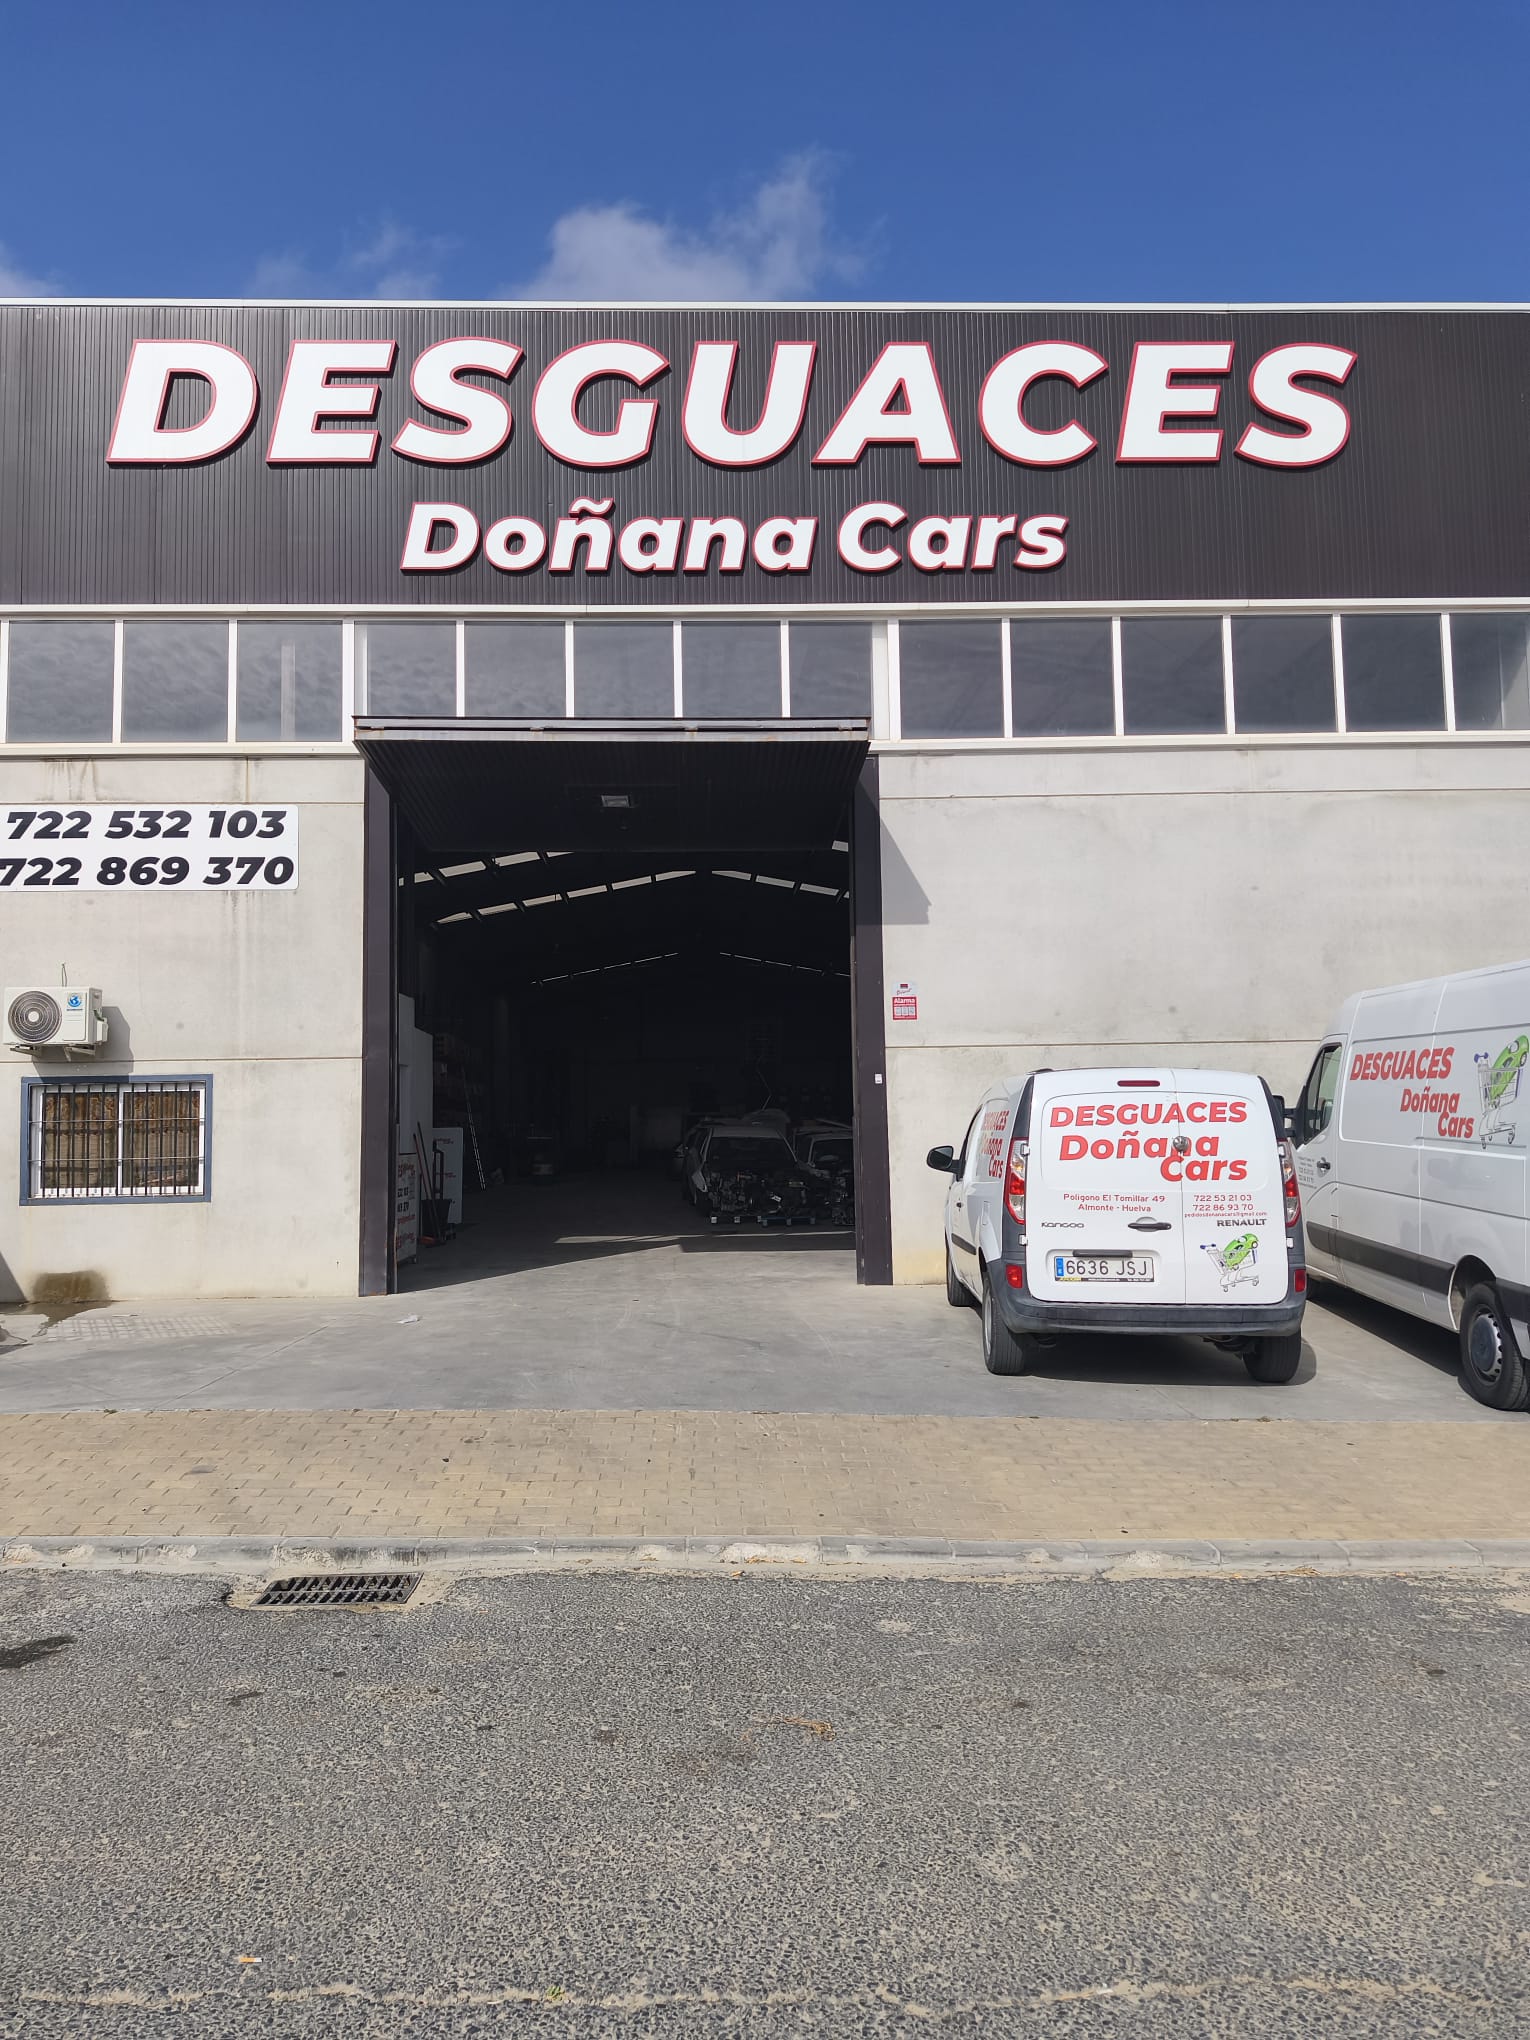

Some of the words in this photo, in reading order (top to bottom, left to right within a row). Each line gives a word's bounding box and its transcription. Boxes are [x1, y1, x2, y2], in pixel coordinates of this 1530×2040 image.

[106, 337, 1357, 467] DESGUACES
[400, 497, 817, 572] Doñana
[838, 501, 1069, 572] Cars
[7, 811, 92, 839] 722
[104, 810, 192, 839] 532
[208, 810, 287, 839] 103
[0, 857, 83, 886] 722
[97, 856, 190, 885] 869
[203, 856, 294, 885] 370
[1350, 1047, 1455, 1080] DESGUACES
[1400, 1086, 1460, 1113] Doñana
[1050, 1101, 1248, 1128] DESGUACES
[1437, 1111, 1474, 1138] Cars
[1160, 1154, 1247, 1182] Cars
[1078, 1203, 1114, 1211] Almonte
[1122, 1204, 1152, 1212] Huelva
[1115, 1194, 1149, 1203] Tomillar
[1152, 1195, 1166, 1203] 49
[1193, 1194, 1212, 1202] 722
[1214, 1194, 1226, 1202] 53
[1242, 1203, 1254, 1211] 70
[1217, 1218, 1267, 1227] RENAULT
[1066, 1260, 1109, 1275] 6636
[1116, 1260, 1147, 1276] JSJ
